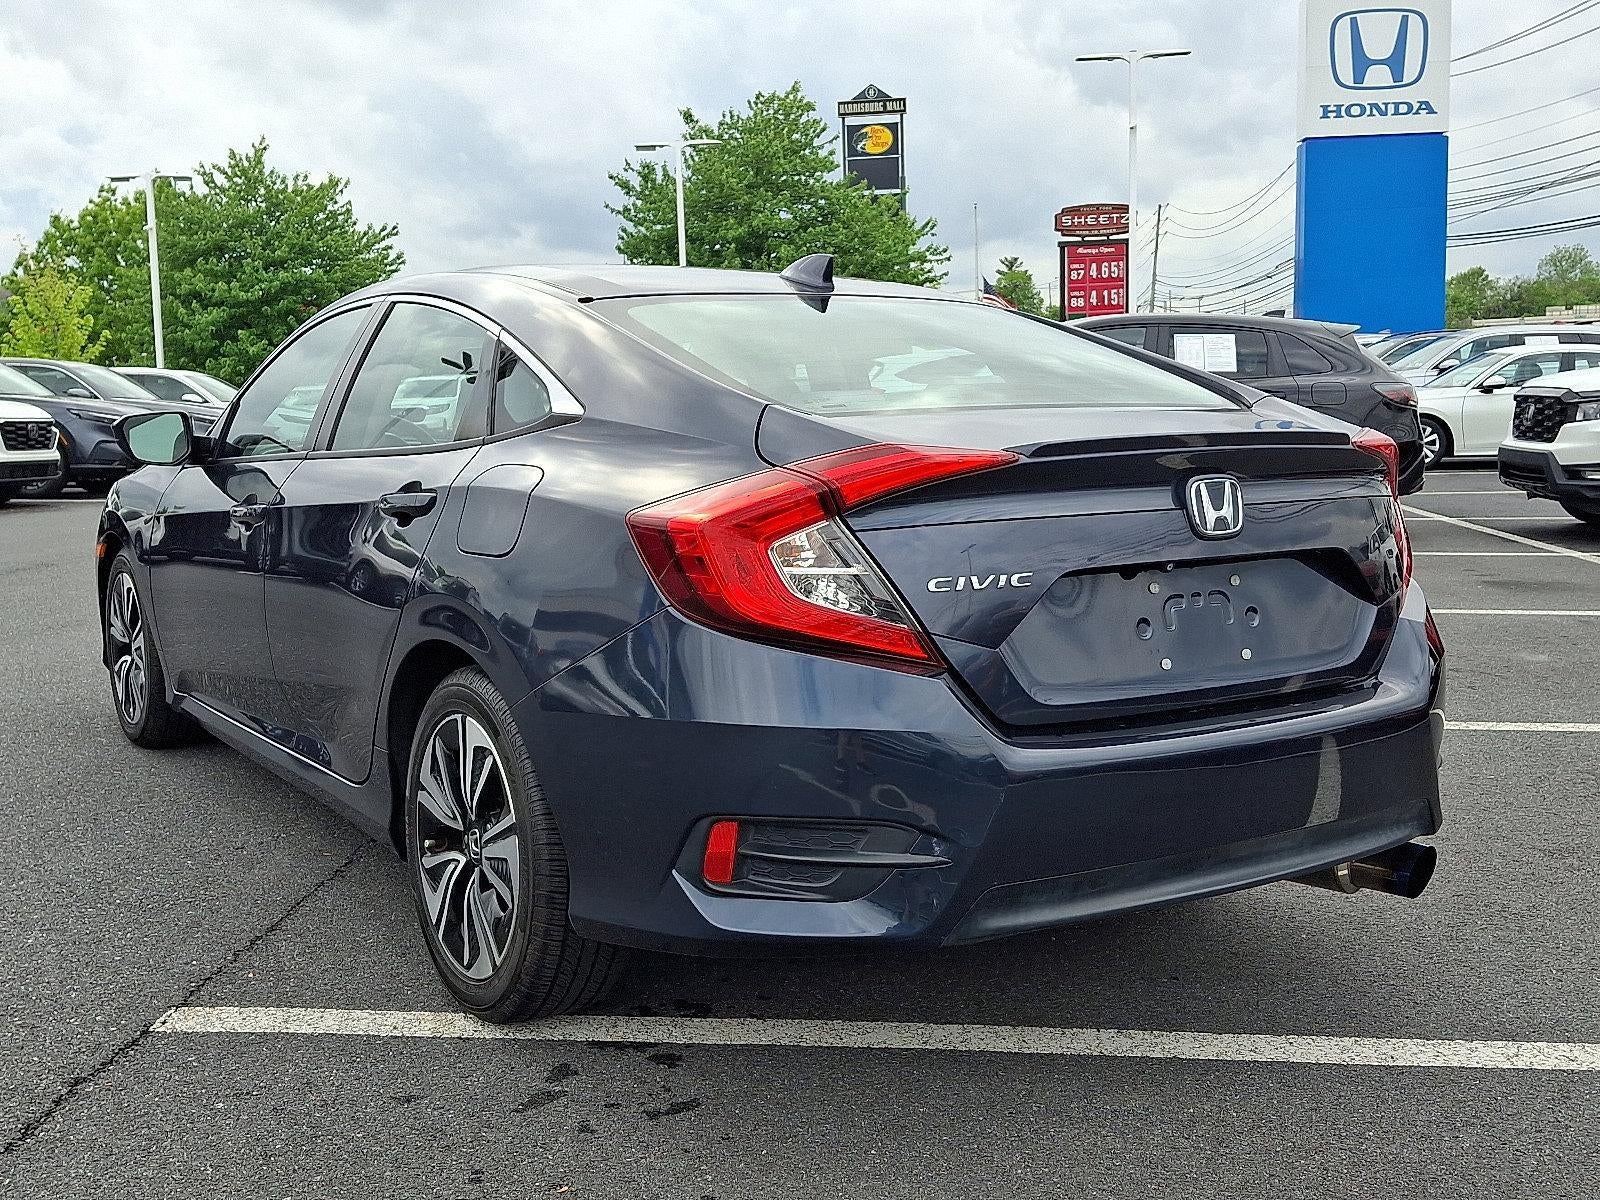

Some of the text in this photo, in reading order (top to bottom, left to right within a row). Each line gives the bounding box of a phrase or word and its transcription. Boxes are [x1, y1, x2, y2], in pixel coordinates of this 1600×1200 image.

[839, 100, 905, 114] HARRISBURG MALL
[1319, 100, 1438, 119] HONDA
[1061, 213, 1130, 226] SHEETZ
[1099, 246, 1116, 254] Open
[1070, 269, 1085, 280] 87
[1070, 297, 1085, 308] 88
[926, 572, 1034, 592] CIVIC
